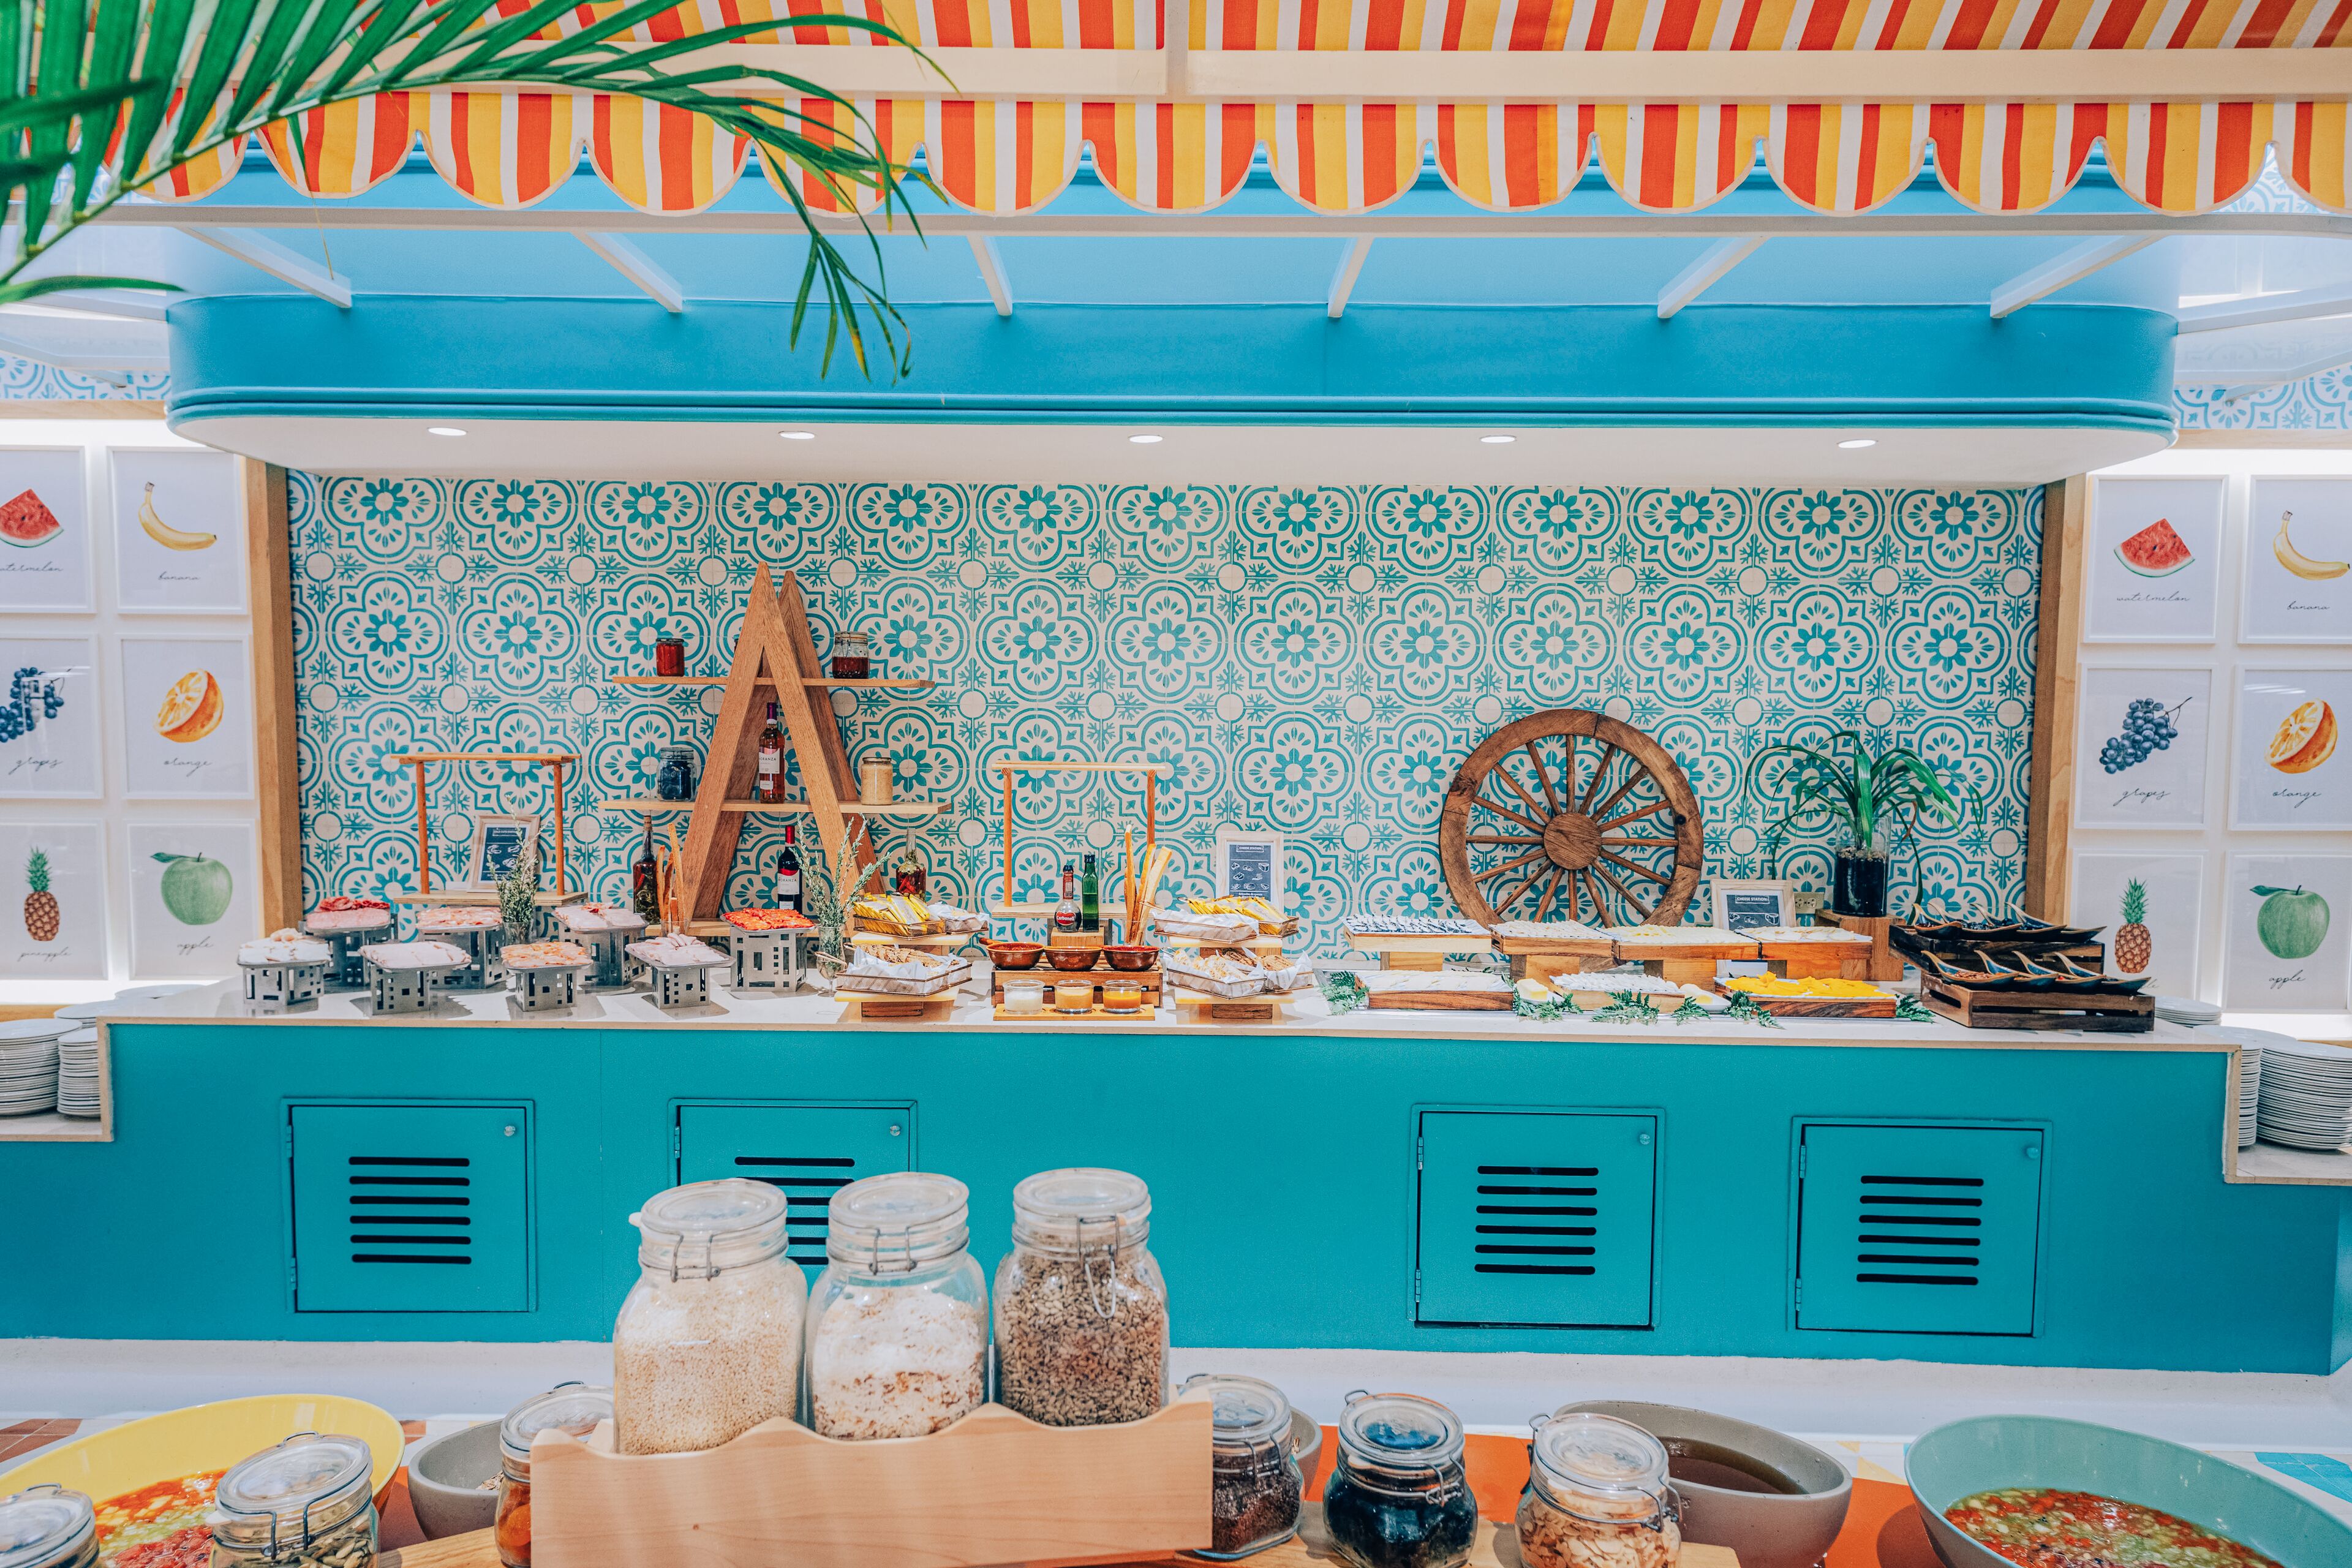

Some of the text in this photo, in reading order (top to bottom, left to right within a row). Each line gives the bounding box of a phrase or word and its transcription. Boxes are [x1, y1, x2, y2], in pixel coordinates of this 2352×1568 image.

[0, 561, 64, 571] atermelon
[157, 571, 202, 581] banana
[2116, 590, 2191, 601] watermelon
[2286, 600, 2331, 611] banana
[8, 756, 64, 775] grapes
[163, 757, 213, 777] orange
[2113, 788, 2171, 807] grapes
[2272, 788, 2322, 809] orange
[17, 946, 73, 962] pineapple
[176, 936, 214, 956] apple
[2269, 970, 2306, 989] apple
